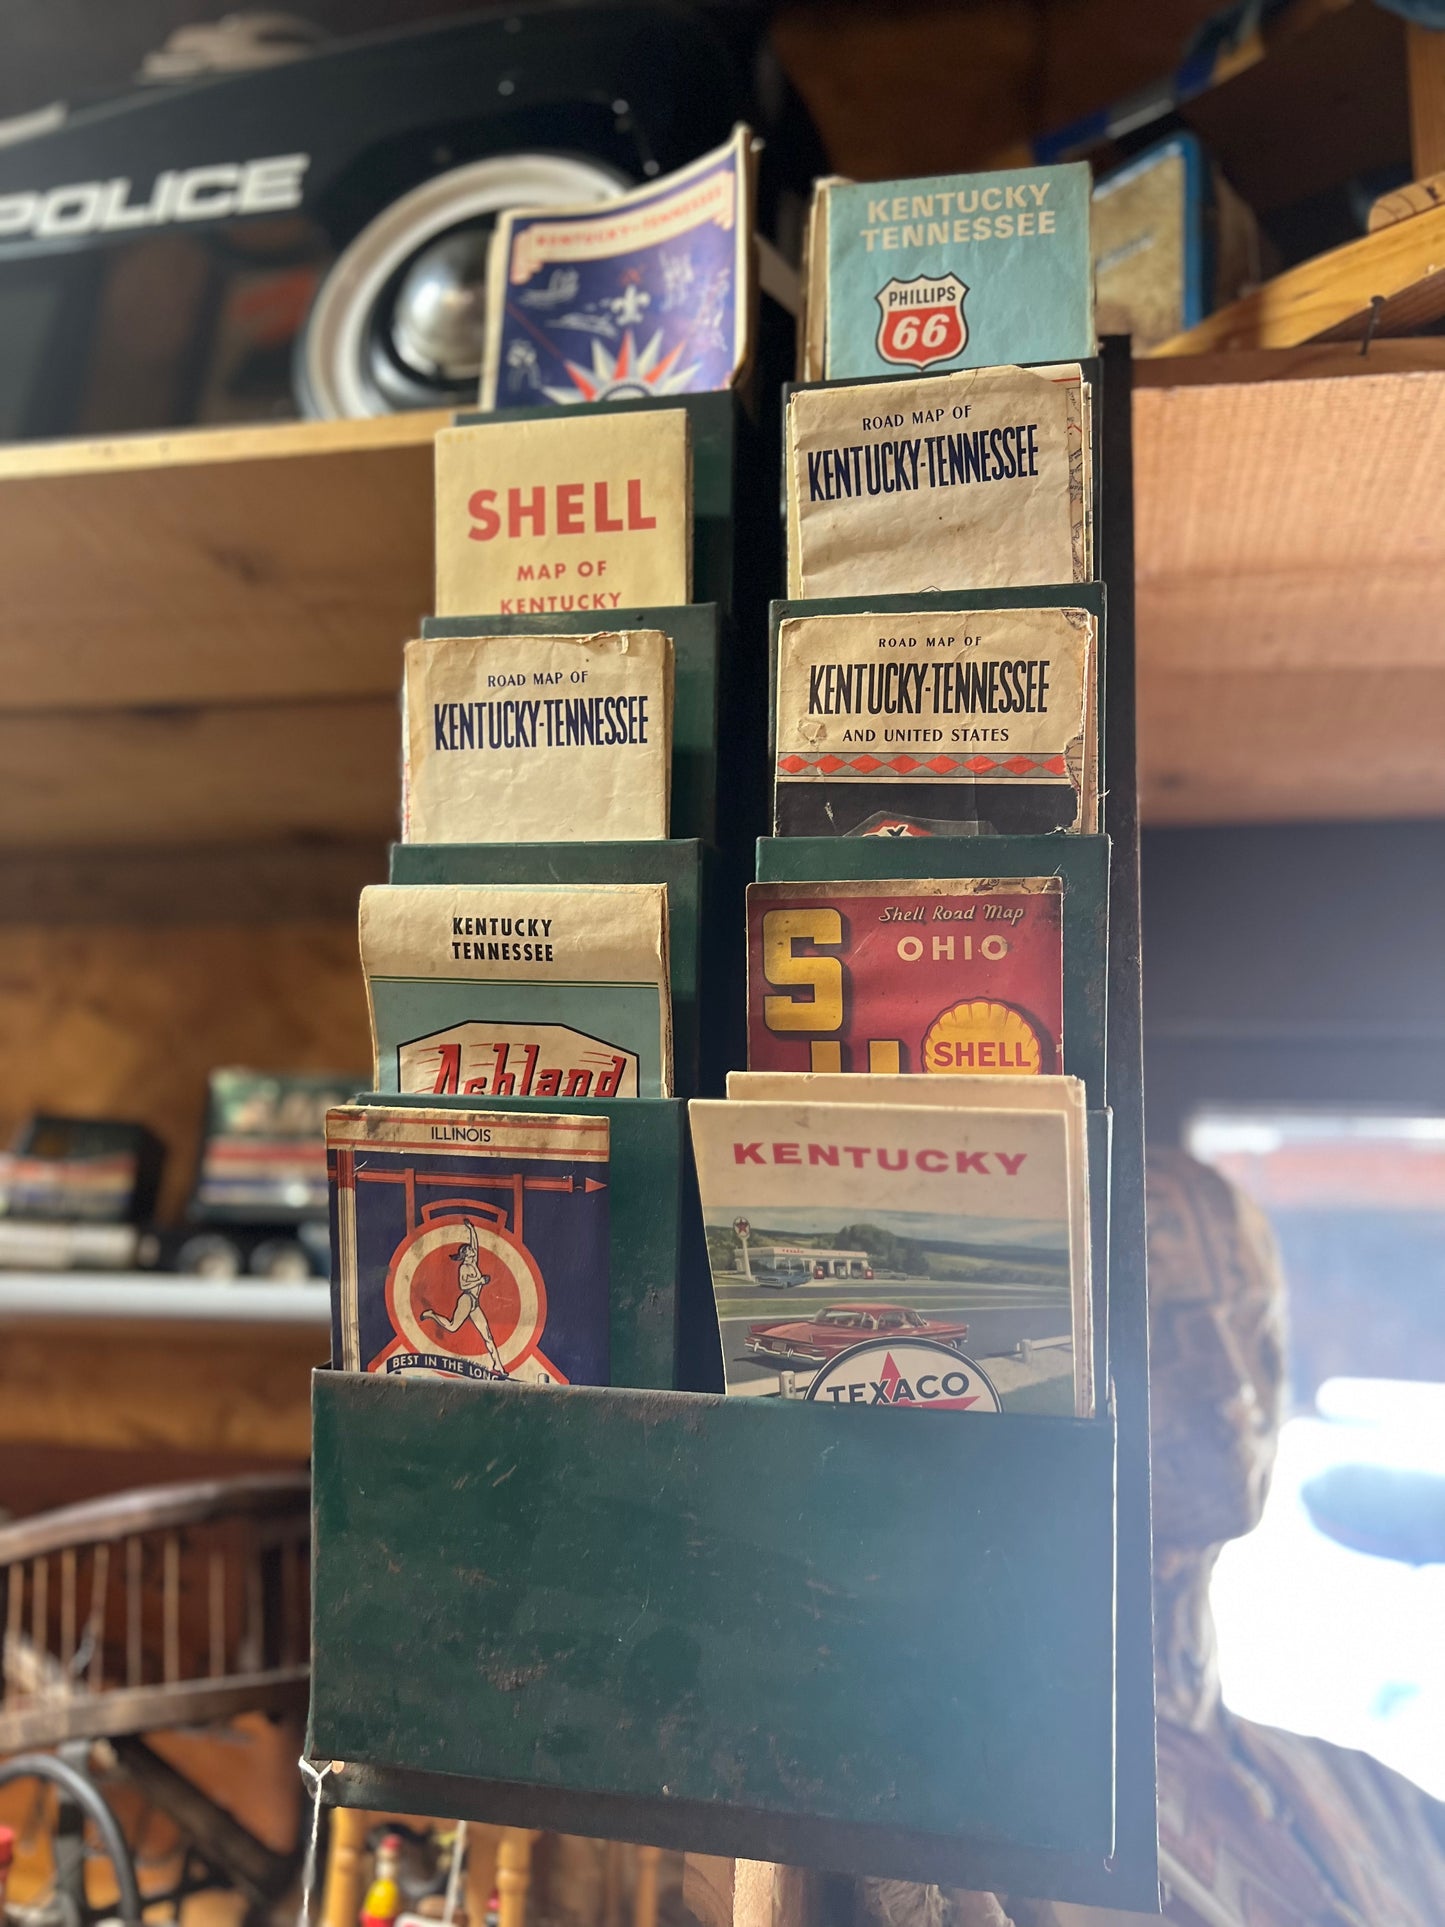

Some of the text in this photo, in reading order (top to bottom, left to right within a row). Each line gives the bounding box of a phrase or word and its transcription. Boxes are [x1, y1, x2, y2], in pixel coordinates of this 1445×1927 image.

[0, 152, 310, 237] POLICE
[867, 183, 1051, 224] KENTUCKY
[860, 211, 1056, 252] TENNESSEE
[888, 286, 957, 307] PHILLIPS
[891, 313, 951, 351] 66
[862, 404, 972, 431] ROAD MAP OF
[808, 424, 1039, 502] KENTUCKY-TENNESSEE
[467, 479, 657, 541] SHELL
[516, 560, 607, 581] MAP OF
[500, 592, 623, 615] KENTUCKY
[878, 636, 982, 648] ROAD MAP OF
[487, 670, 588, 688] ROAD MAP OF
[808, 660, 1050, 715] KENTUCKY-TENNESSEE
[434, 695, 649, 750] KENTUCKY-TENNESSEE
[842, 728, 1009, 742] AND UNITED STATES
[452, 917, 553, 937] KENTUCKY
[878, 904, 1025, 925] Shell Road Map
[451, 942, 554, 962] TENNESSEE
[897, 934, 1009, 962] OHIO
[933, 1041, 1032, 1067] SHELL
[433, 1043, 627, 1097] Ashland
[431, 1126, 492, 1143] ILLINOIS
[733, 1142, 1028, 1175] KENTUCKY
[392, 1355, 419, 1369] BEST
[424, 1355, 437, 1367] IN
[441, 1358, 464, 1373] THE
[826, 1371, 970, 1406] TEXACO
